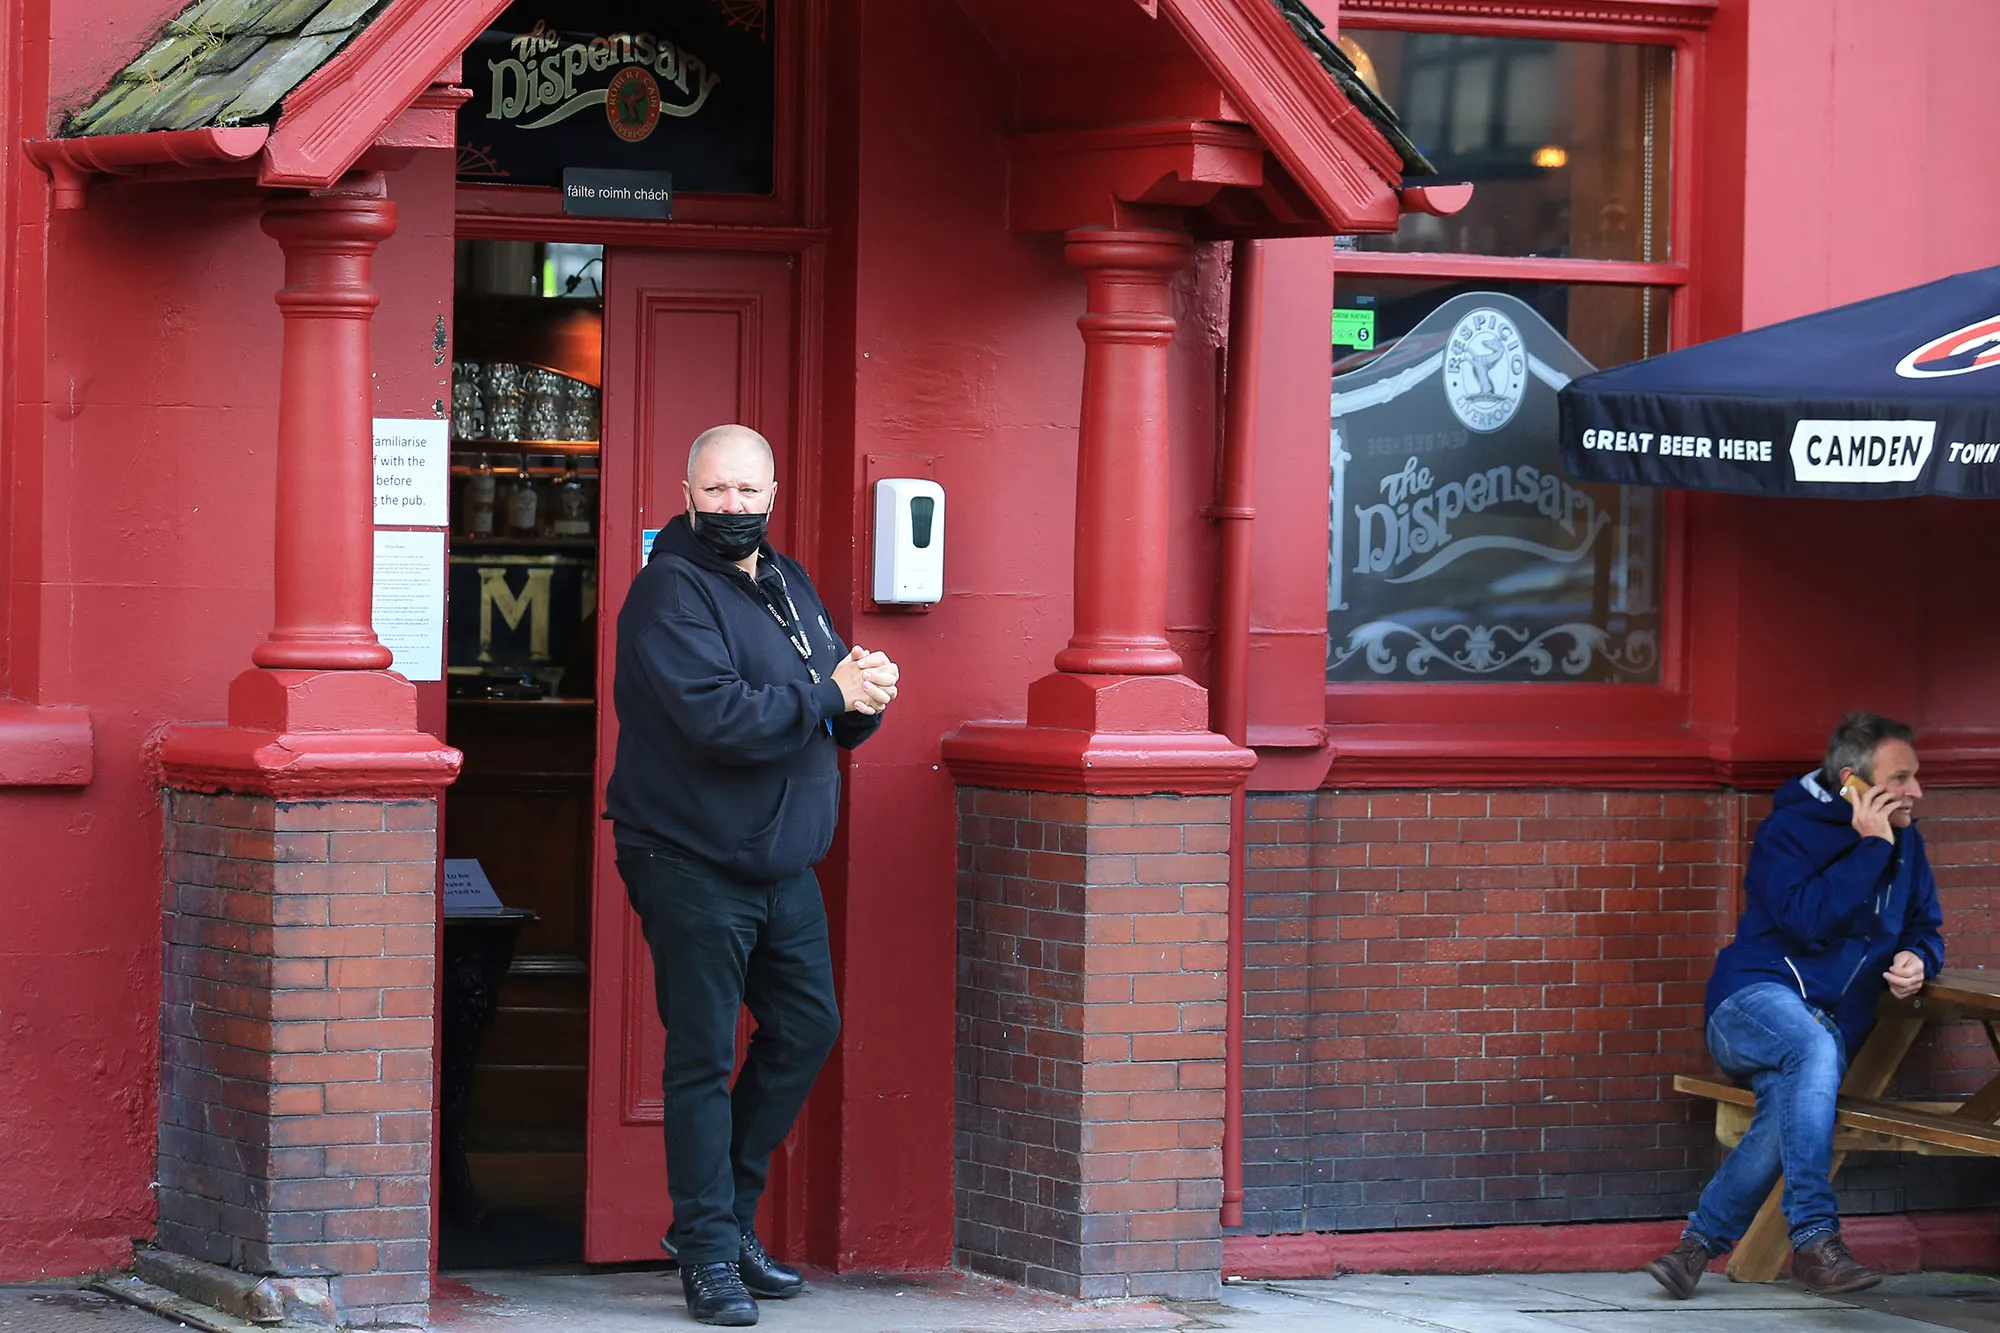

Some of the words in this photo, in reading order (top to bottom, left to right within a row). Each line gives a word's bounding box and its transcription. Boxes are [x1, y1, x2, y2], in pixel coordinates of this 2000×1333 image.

[609, 71, 640, 105] ROBERT
[644, 78, 657, 108] CAIN
[613, 117, 654, 138] LIVERPOOL
[567, 185, 595, 197] fáilte
[599, 187, 631, 199] roimh
[634, 188, 669, 200] chách
[1360, 329, 1368, 340] 5
[1447, 314, 1523, 374] RESPICIO
[1457, 396, 1517, 427] LIVERPOOL
[1582, 429, 1654, 454] GREAT
[1659, 434, 1712, 458] BEER
[1718, 439, 1773, 462] HERE
[1806, 434, 1923, 467] CAMDEN
[1948, 442, 2000, 464] TOWN
[380, 456, 405, 466] with
[408, 456, 425, 467] the
[376, 474, 412, 486] before
[381, 495, 399, 506] the
[402, 495, 426, 508] pub.
[767, 603, 787, 627] SECURITY
[790, 635, 809, 659] SECURITY
